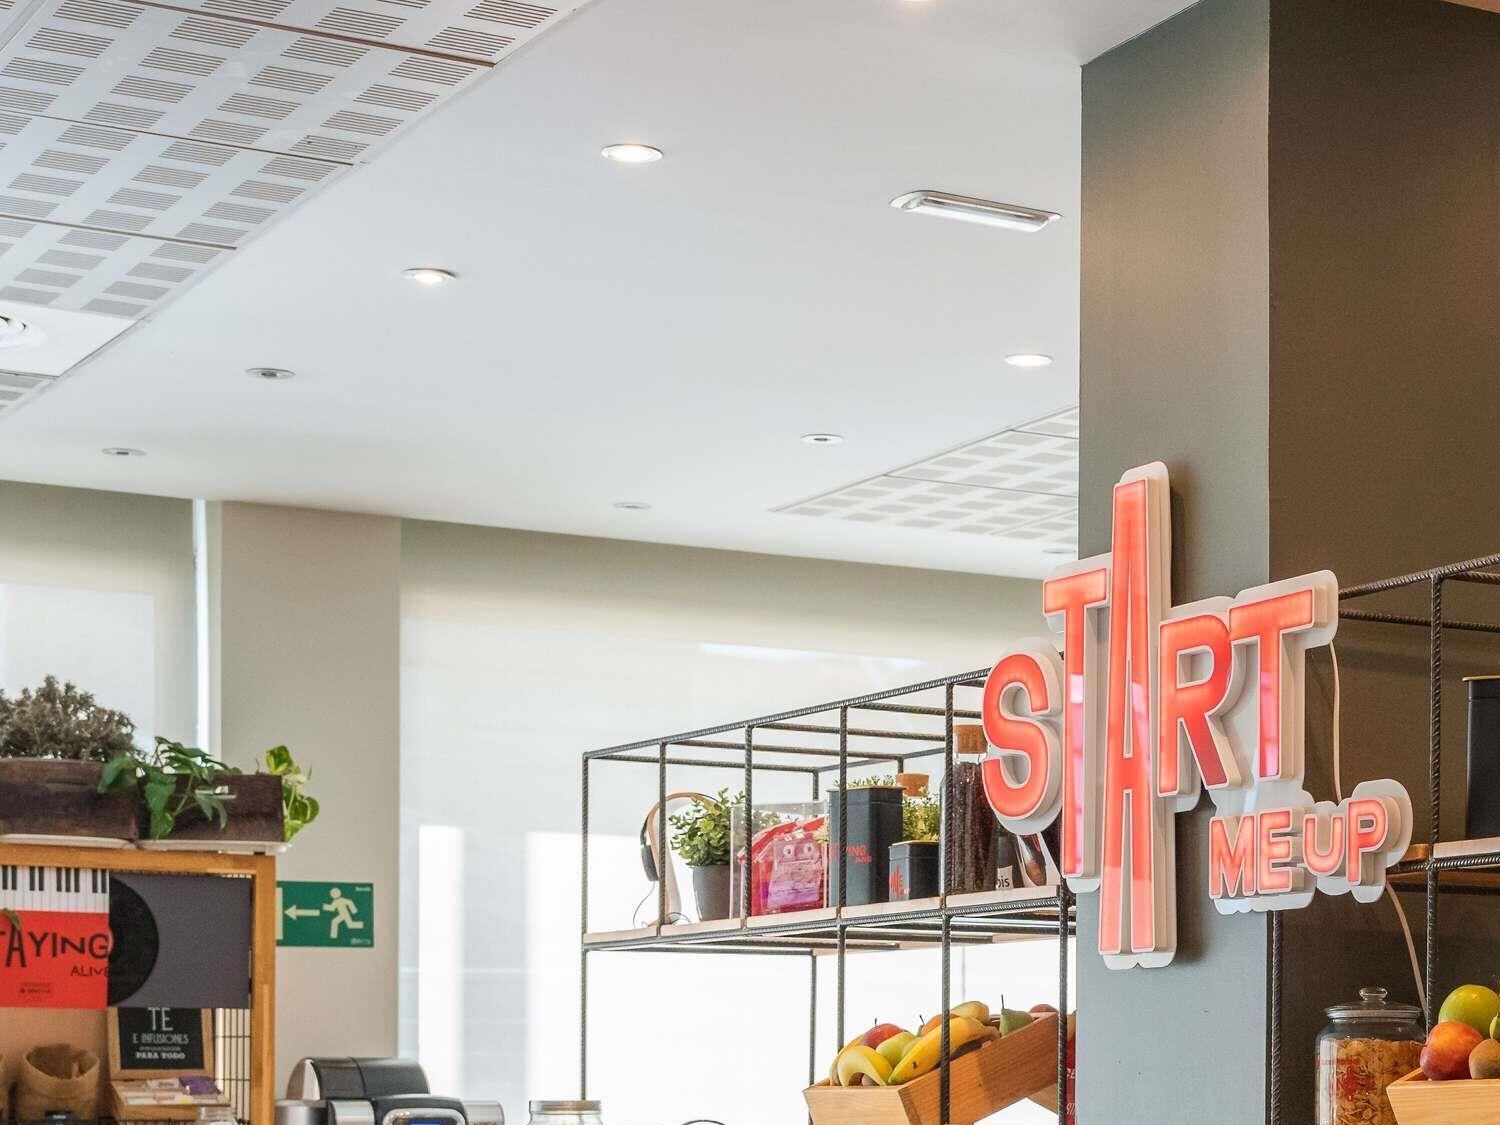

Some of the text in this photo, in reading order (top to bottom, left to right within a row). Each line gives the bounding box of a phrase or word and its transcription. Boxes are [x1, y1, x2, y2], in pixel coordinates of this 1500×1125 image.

[981, 477, 1314, 954] START
[1209, 798, 1389, 899] ME UP
